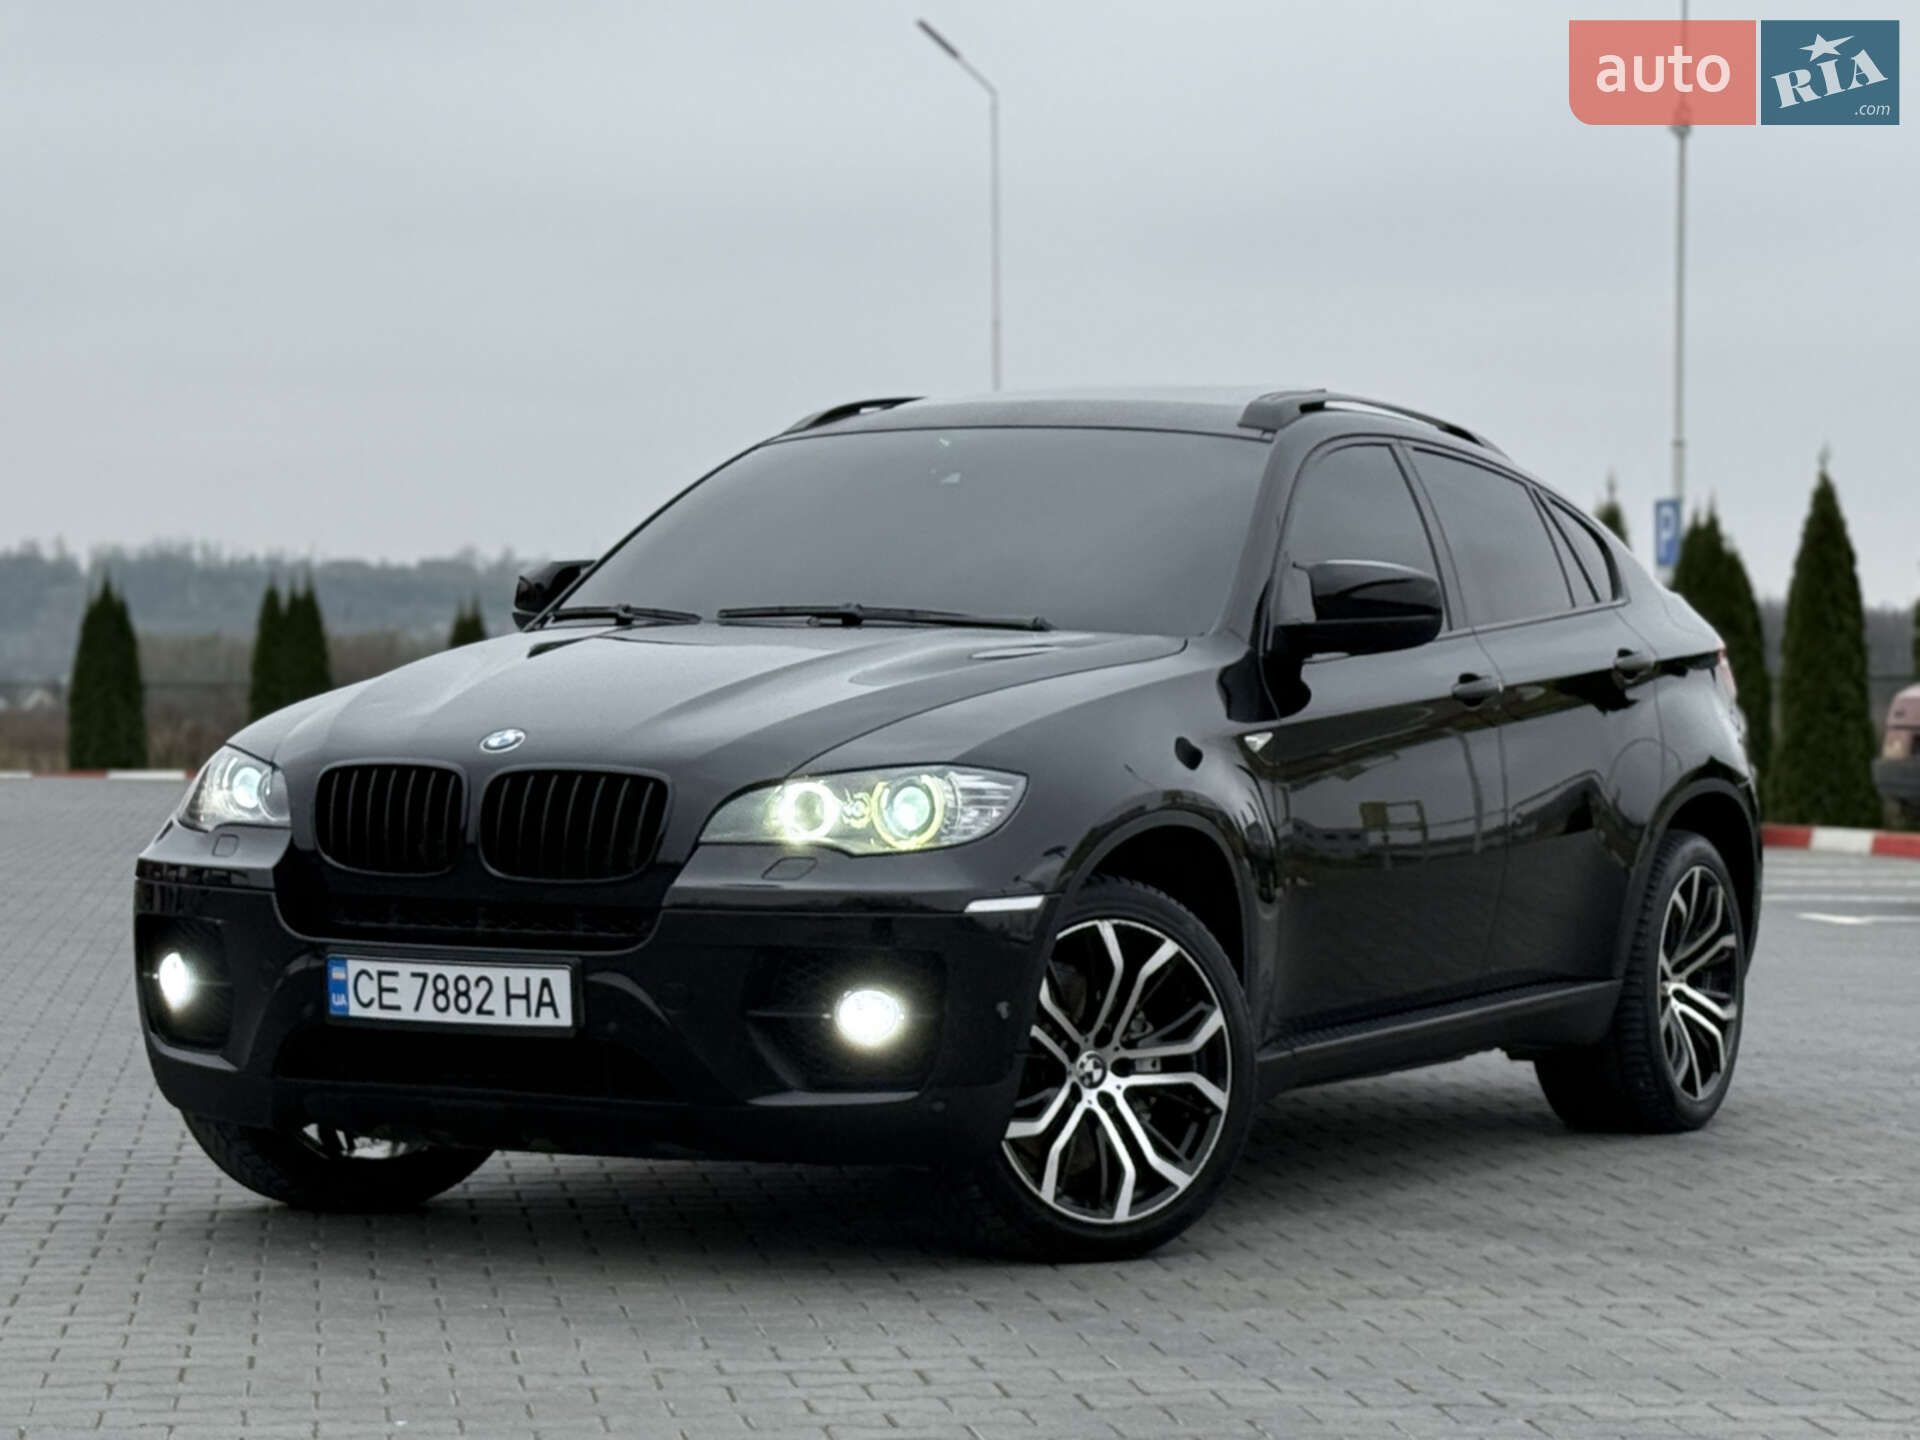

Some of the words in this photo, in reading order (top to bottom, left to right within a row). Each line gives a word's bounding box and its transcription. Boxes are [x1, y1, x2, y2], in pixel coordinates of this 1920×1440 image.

[331, 992, 347, 1006] UA
[353, 968, 401, 1011] CE
[410, 972, 495, 1016] 7882
[504, 976, 560, 1019] HA
